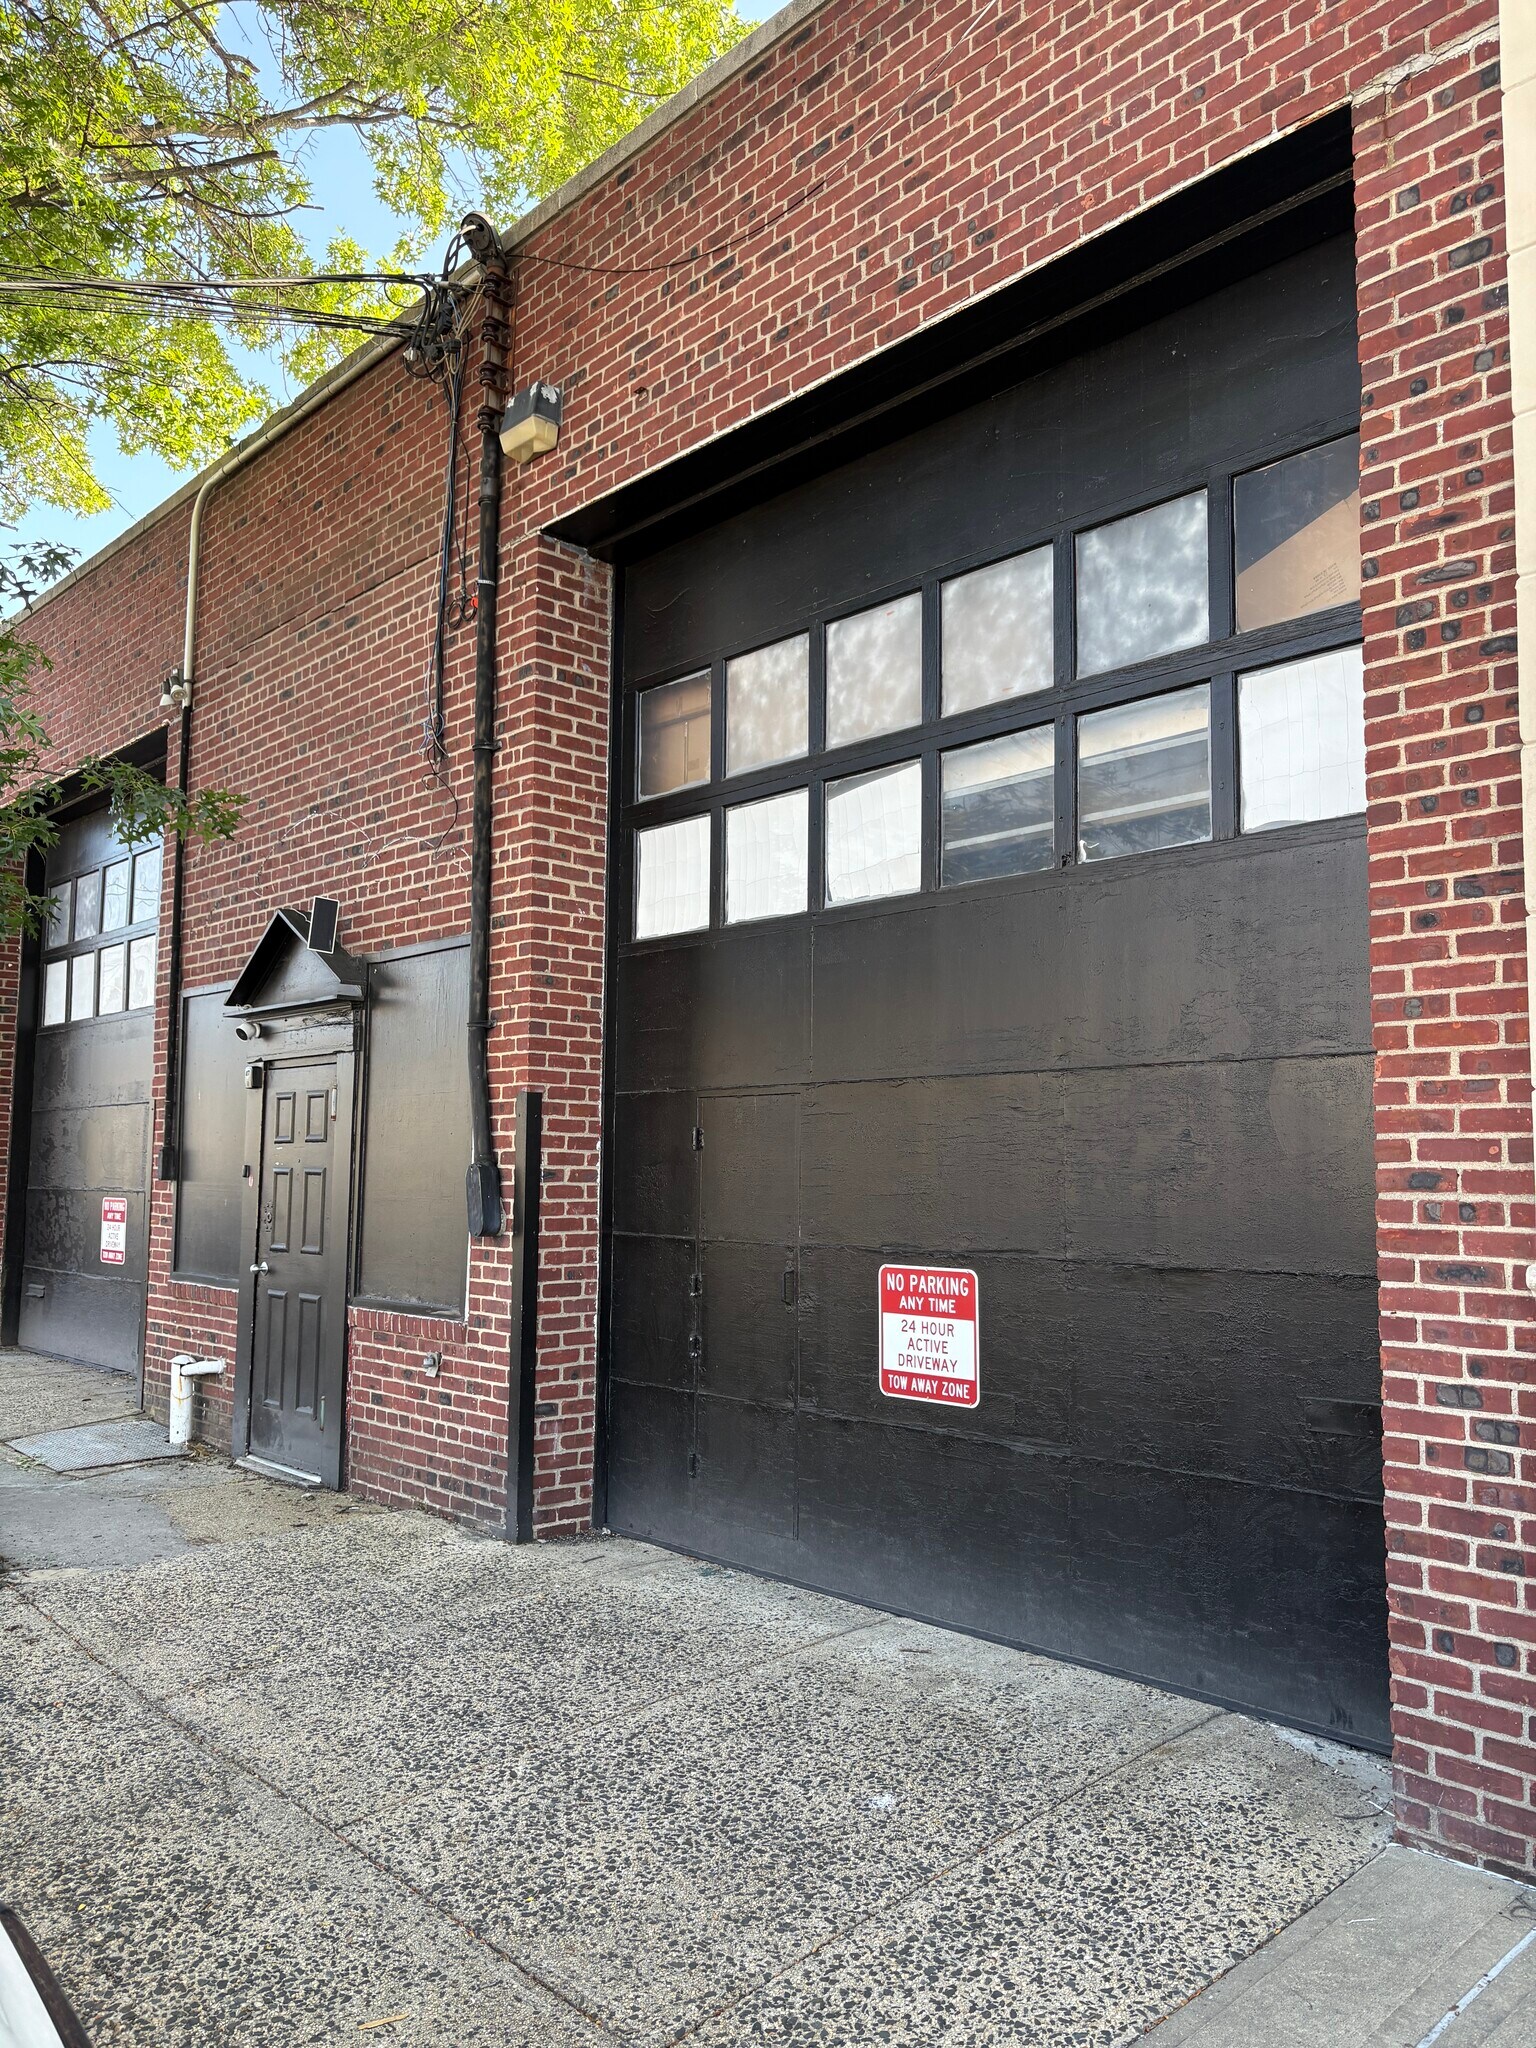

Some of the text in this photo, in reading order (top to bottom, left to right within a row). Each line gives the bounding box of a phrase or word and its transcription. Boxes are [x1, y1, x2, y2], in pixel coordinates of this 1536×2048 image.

[886, 1273, 969, 1297] NO PARKING
[899, 1295, 956, 1314] ANY TIME
[901, 1319, 954, 1337] 24 HOUR
[907, 1337, 949, 1355] ACTIVE
[898, 1353, 958, 1373] DRIVEWAY
[888, 1374, 970, 1399] TOW AWAY ZONE
